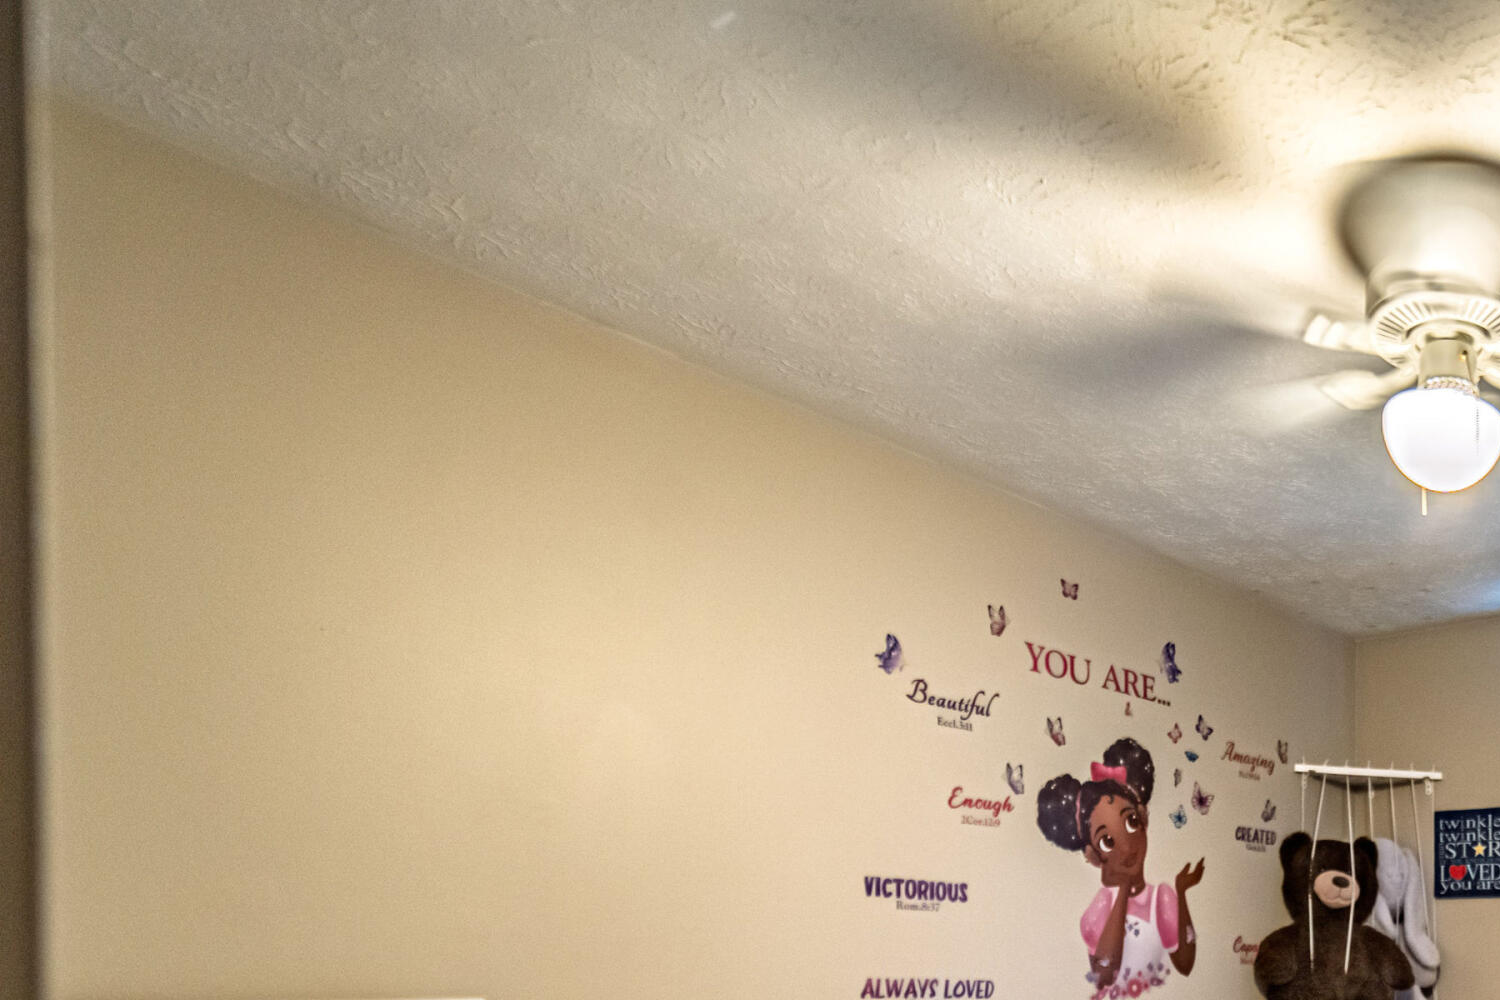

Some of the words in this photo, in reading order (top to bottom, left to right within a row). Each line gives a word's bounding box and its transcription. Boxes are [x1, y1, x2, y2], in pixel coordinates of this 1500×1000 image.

[1024, 641, 1092, 685] YOU
[906, 678, 999, 720] Beautiful
[1221, 741, 1274, 776] Amazing
[948, 786, 1014, 817] Enough
[1235, 826, 1277, 845] CREATED
[863, 876, 968, 903] VICTORIOUS
[1440, 880, 1472, 894] you
[860, 978, 938, 999] ALWAYS
[943, 979, 995, 999] LOVED
